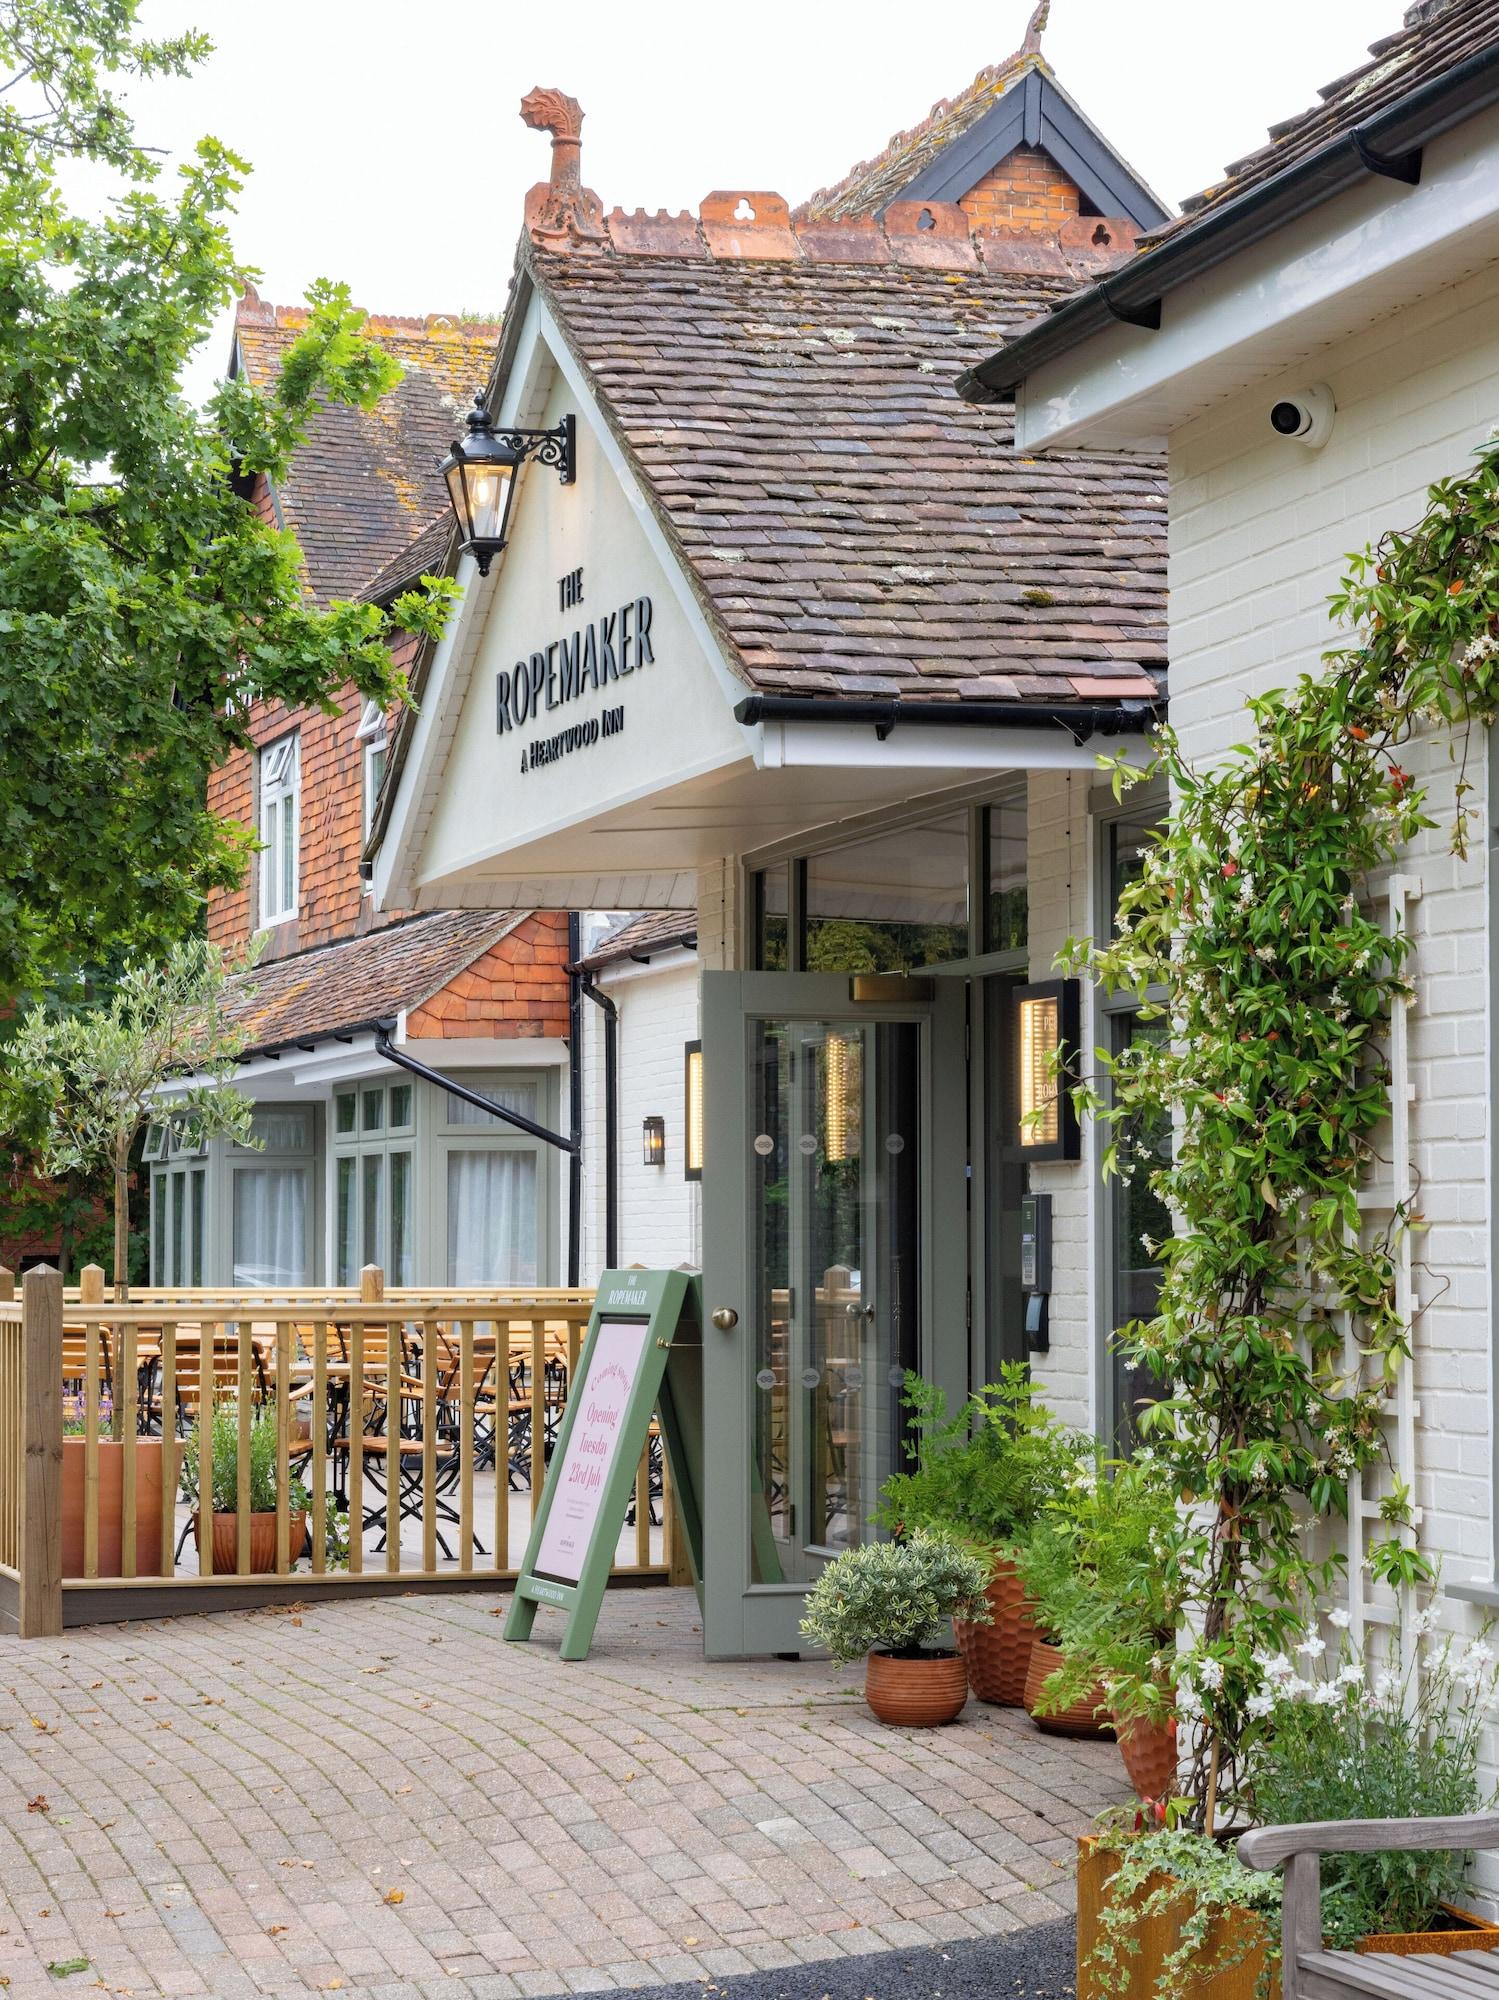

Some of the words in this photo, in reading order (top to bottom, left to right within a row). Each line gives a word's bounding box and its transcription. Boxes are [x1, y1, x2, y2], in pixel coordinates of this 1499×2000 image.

[557, 566, 584, 612] THE
[496, 595, 655, 735] ROPEMAKER
[520, 749, 529, 774] A
[529, 717, 599, 769] HEARTWOOD
[601, 705, 625, 738] INN
[607, 1288, 648, 1306] ROPEMAKER
[590, 1361, 619, 1392] Coming
[586, 1401, 620, 1431] Opening
[579, 1432, 609, 1462] Tuesday
[568, 1461, 589, 1487] 23rd
[585, 1465, 601, 1493] July
